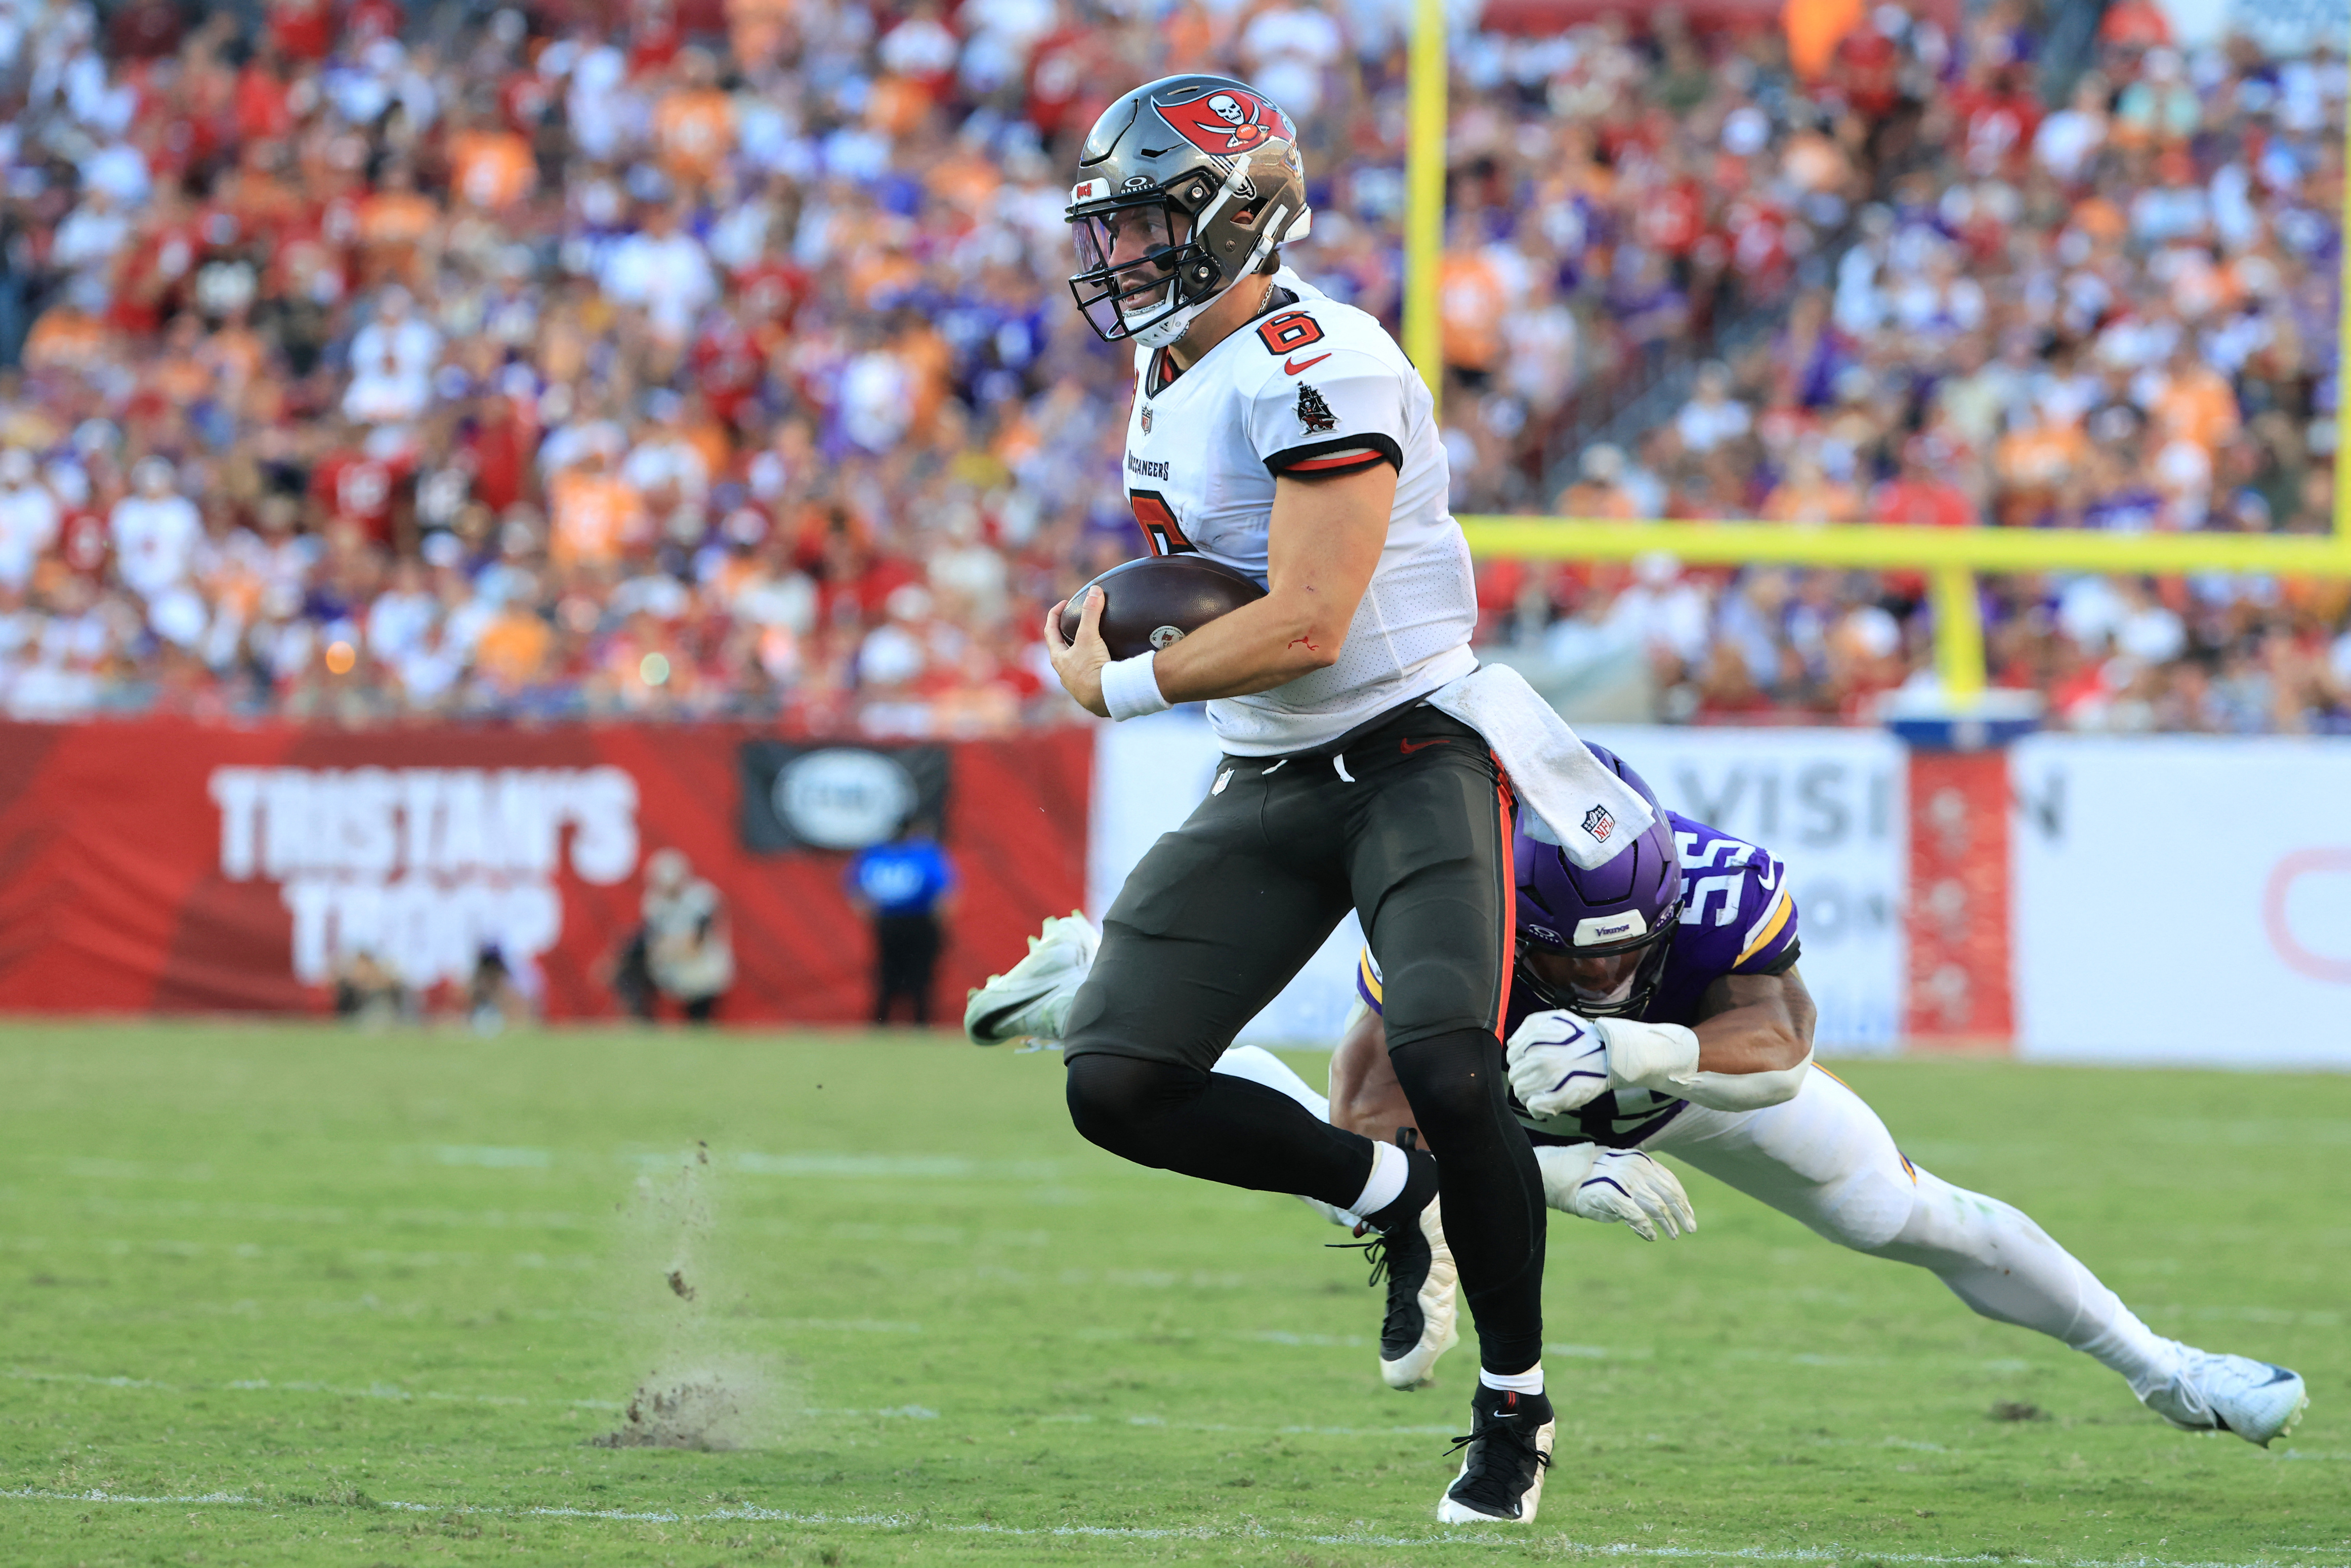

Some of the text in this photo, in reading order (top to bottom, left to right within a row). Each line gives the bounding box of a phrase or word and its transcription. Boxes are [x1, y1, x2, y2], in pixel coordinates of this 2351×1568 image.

[1121, 184, 1154, 194] OAKLEY
[1255, 311, 1325, 356] 6
[1128, 448, 1169, 482] BUCCANEERS
[210, 765, 639, 885] TRISTAN'S
[1673, 762, 2069, 848] VISIN
[1594, 817, 1613, 840] NFL
[1675, 830, 1757, 927] 55
